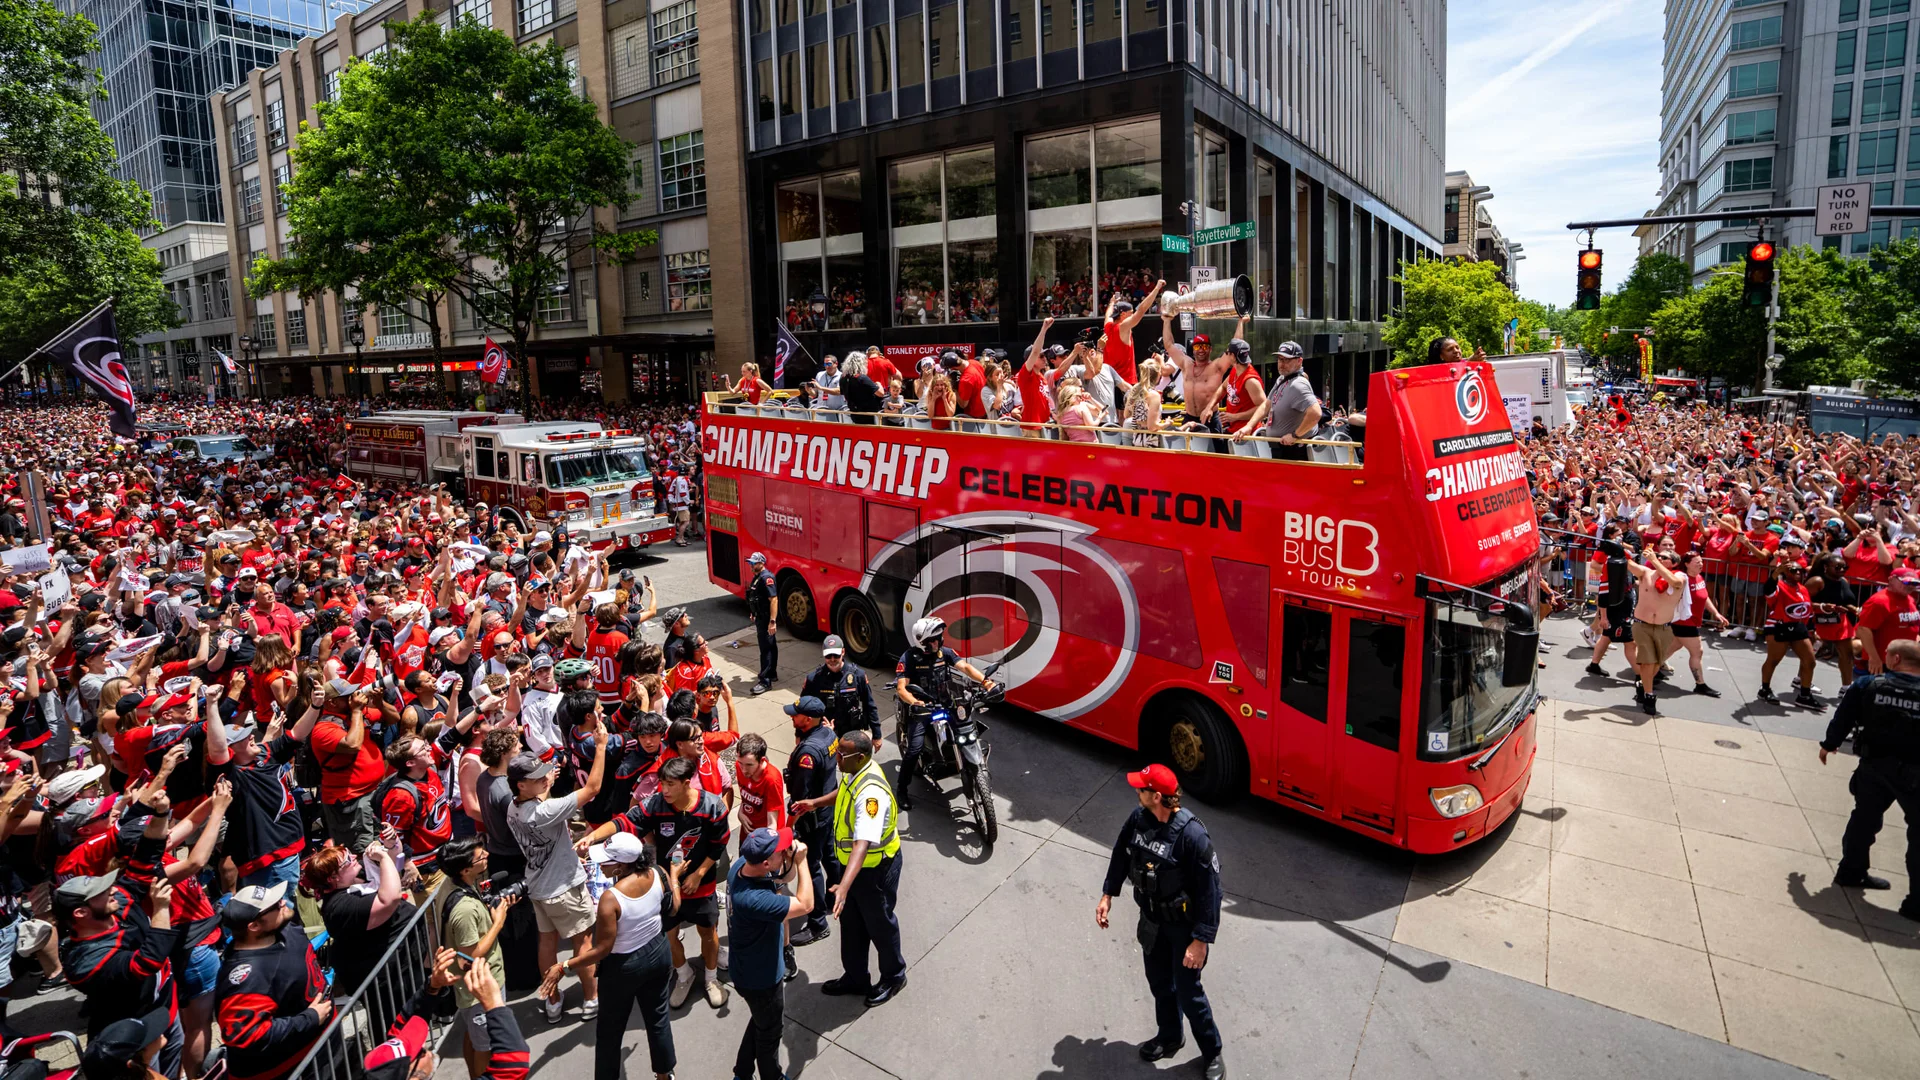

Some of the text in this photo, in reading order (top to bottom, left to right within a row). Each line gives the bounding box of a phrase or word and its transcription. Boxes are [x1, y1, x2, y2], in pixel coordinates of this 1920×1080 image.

[1833, 188, 1855, 199] NO
[1828, 200, 1859, 210] TURN
[1834, 212, 1850, 220] ON
[1196, 222, 1253, 243] Fayetteville ST
[1245, 230, 1256, 238] 300
[1830, 222, 1853, 231] RED
[1166, 238, 1186, 251] Davie
[886, 347, 917, 355] STANLEY
[919, 346, 934, 354] CUP
[1825, 400, 1857, 408] BULKOGI
[1866, 404, 1895, 412] KOREAN
[355, 427, 415, 440] CITY OF RALEIGH
[1439, 431, 1514, 453] CAROLINA HURRICANES
[573, 451, 601, 459] STANLEY
[617, 446, 646, 454] CHAMPIONS
[703, 424, 950, 499] CHAMPIONSHIP
[594, 483, 625, 492] RALEIGH
[959, 466, 1242, 532] CELEBRATION
[1457, 485, 1530, 522] CELEBRATION
[602, 500, 622, 523] 14
[765, 509, 803, 531] SIREN
[1284, 511, 1335, 544] BIG
[1477, 520, 1532, 550] SOUND THE SIREN
[1283, 539, 1334, 570] BUS
[1300, 569, 1356, 591] TOURS
[1500, 570, 1528, 598] BIGBUS.COM
[1218, 665, 1230, 673] VEC
[1218, 671, 1230, 679] TOR
[1874, 693, 1920, 711] POLICE
